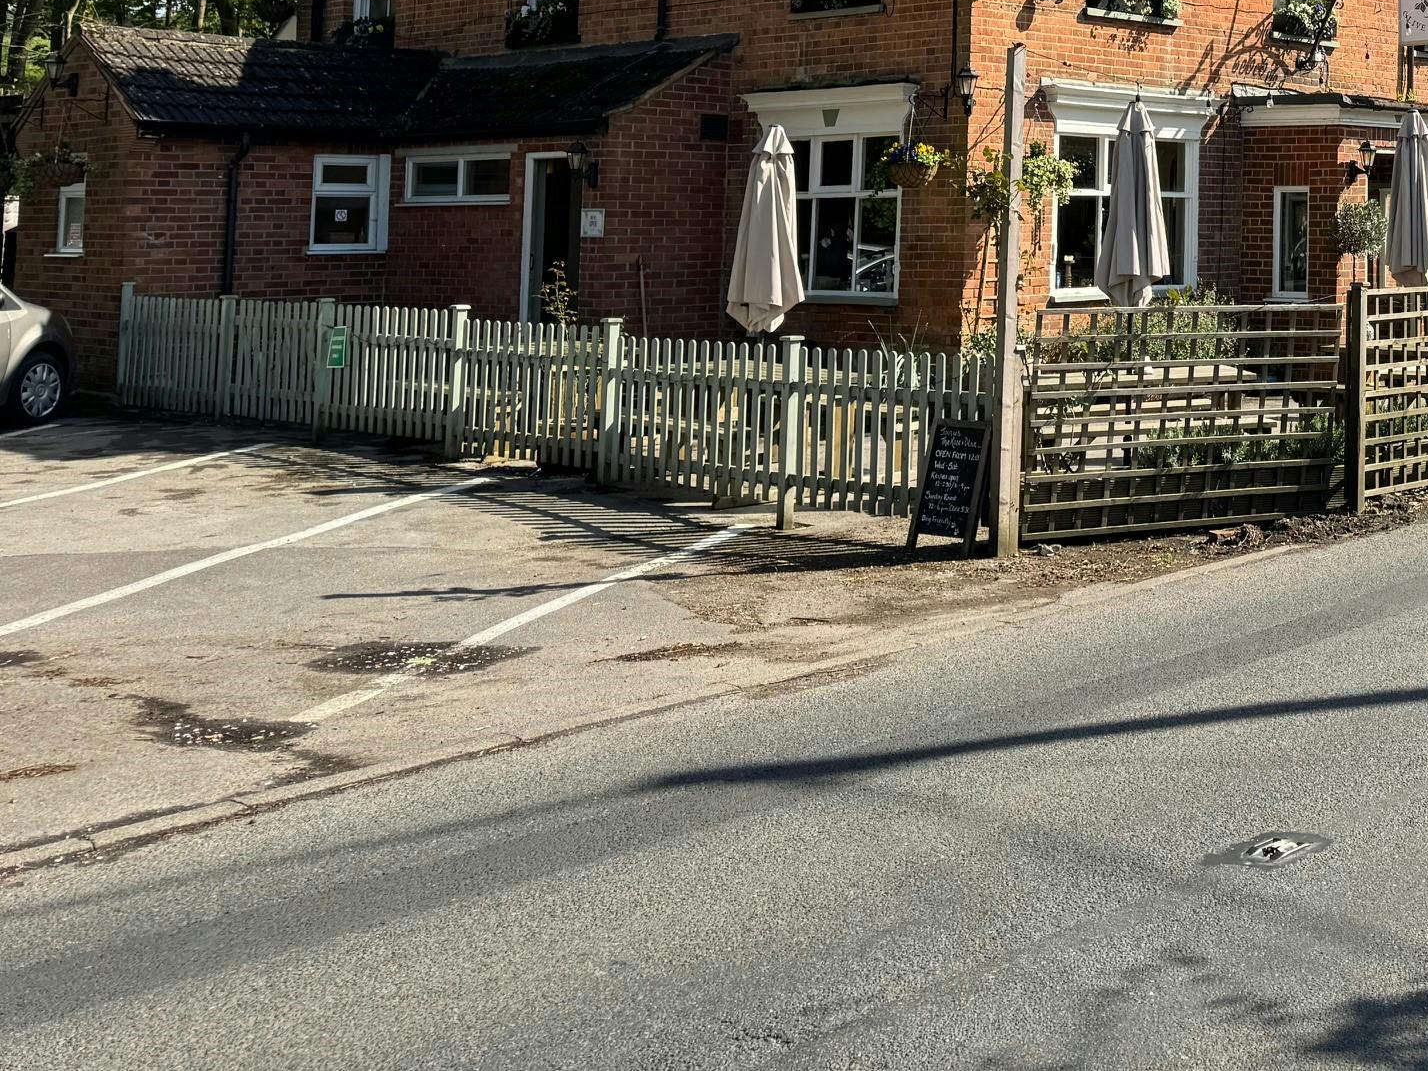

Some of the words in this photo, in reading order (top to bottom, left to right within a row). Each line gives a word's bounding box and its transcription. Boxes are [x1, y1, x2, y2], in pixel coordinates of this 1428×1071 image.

[1403, 11, 1426, 31] OLIVE
[935, 449, 951, 458] OPEN
[951, 451, 967, 461] FROM
[921, 514, 932, 525] Dog
